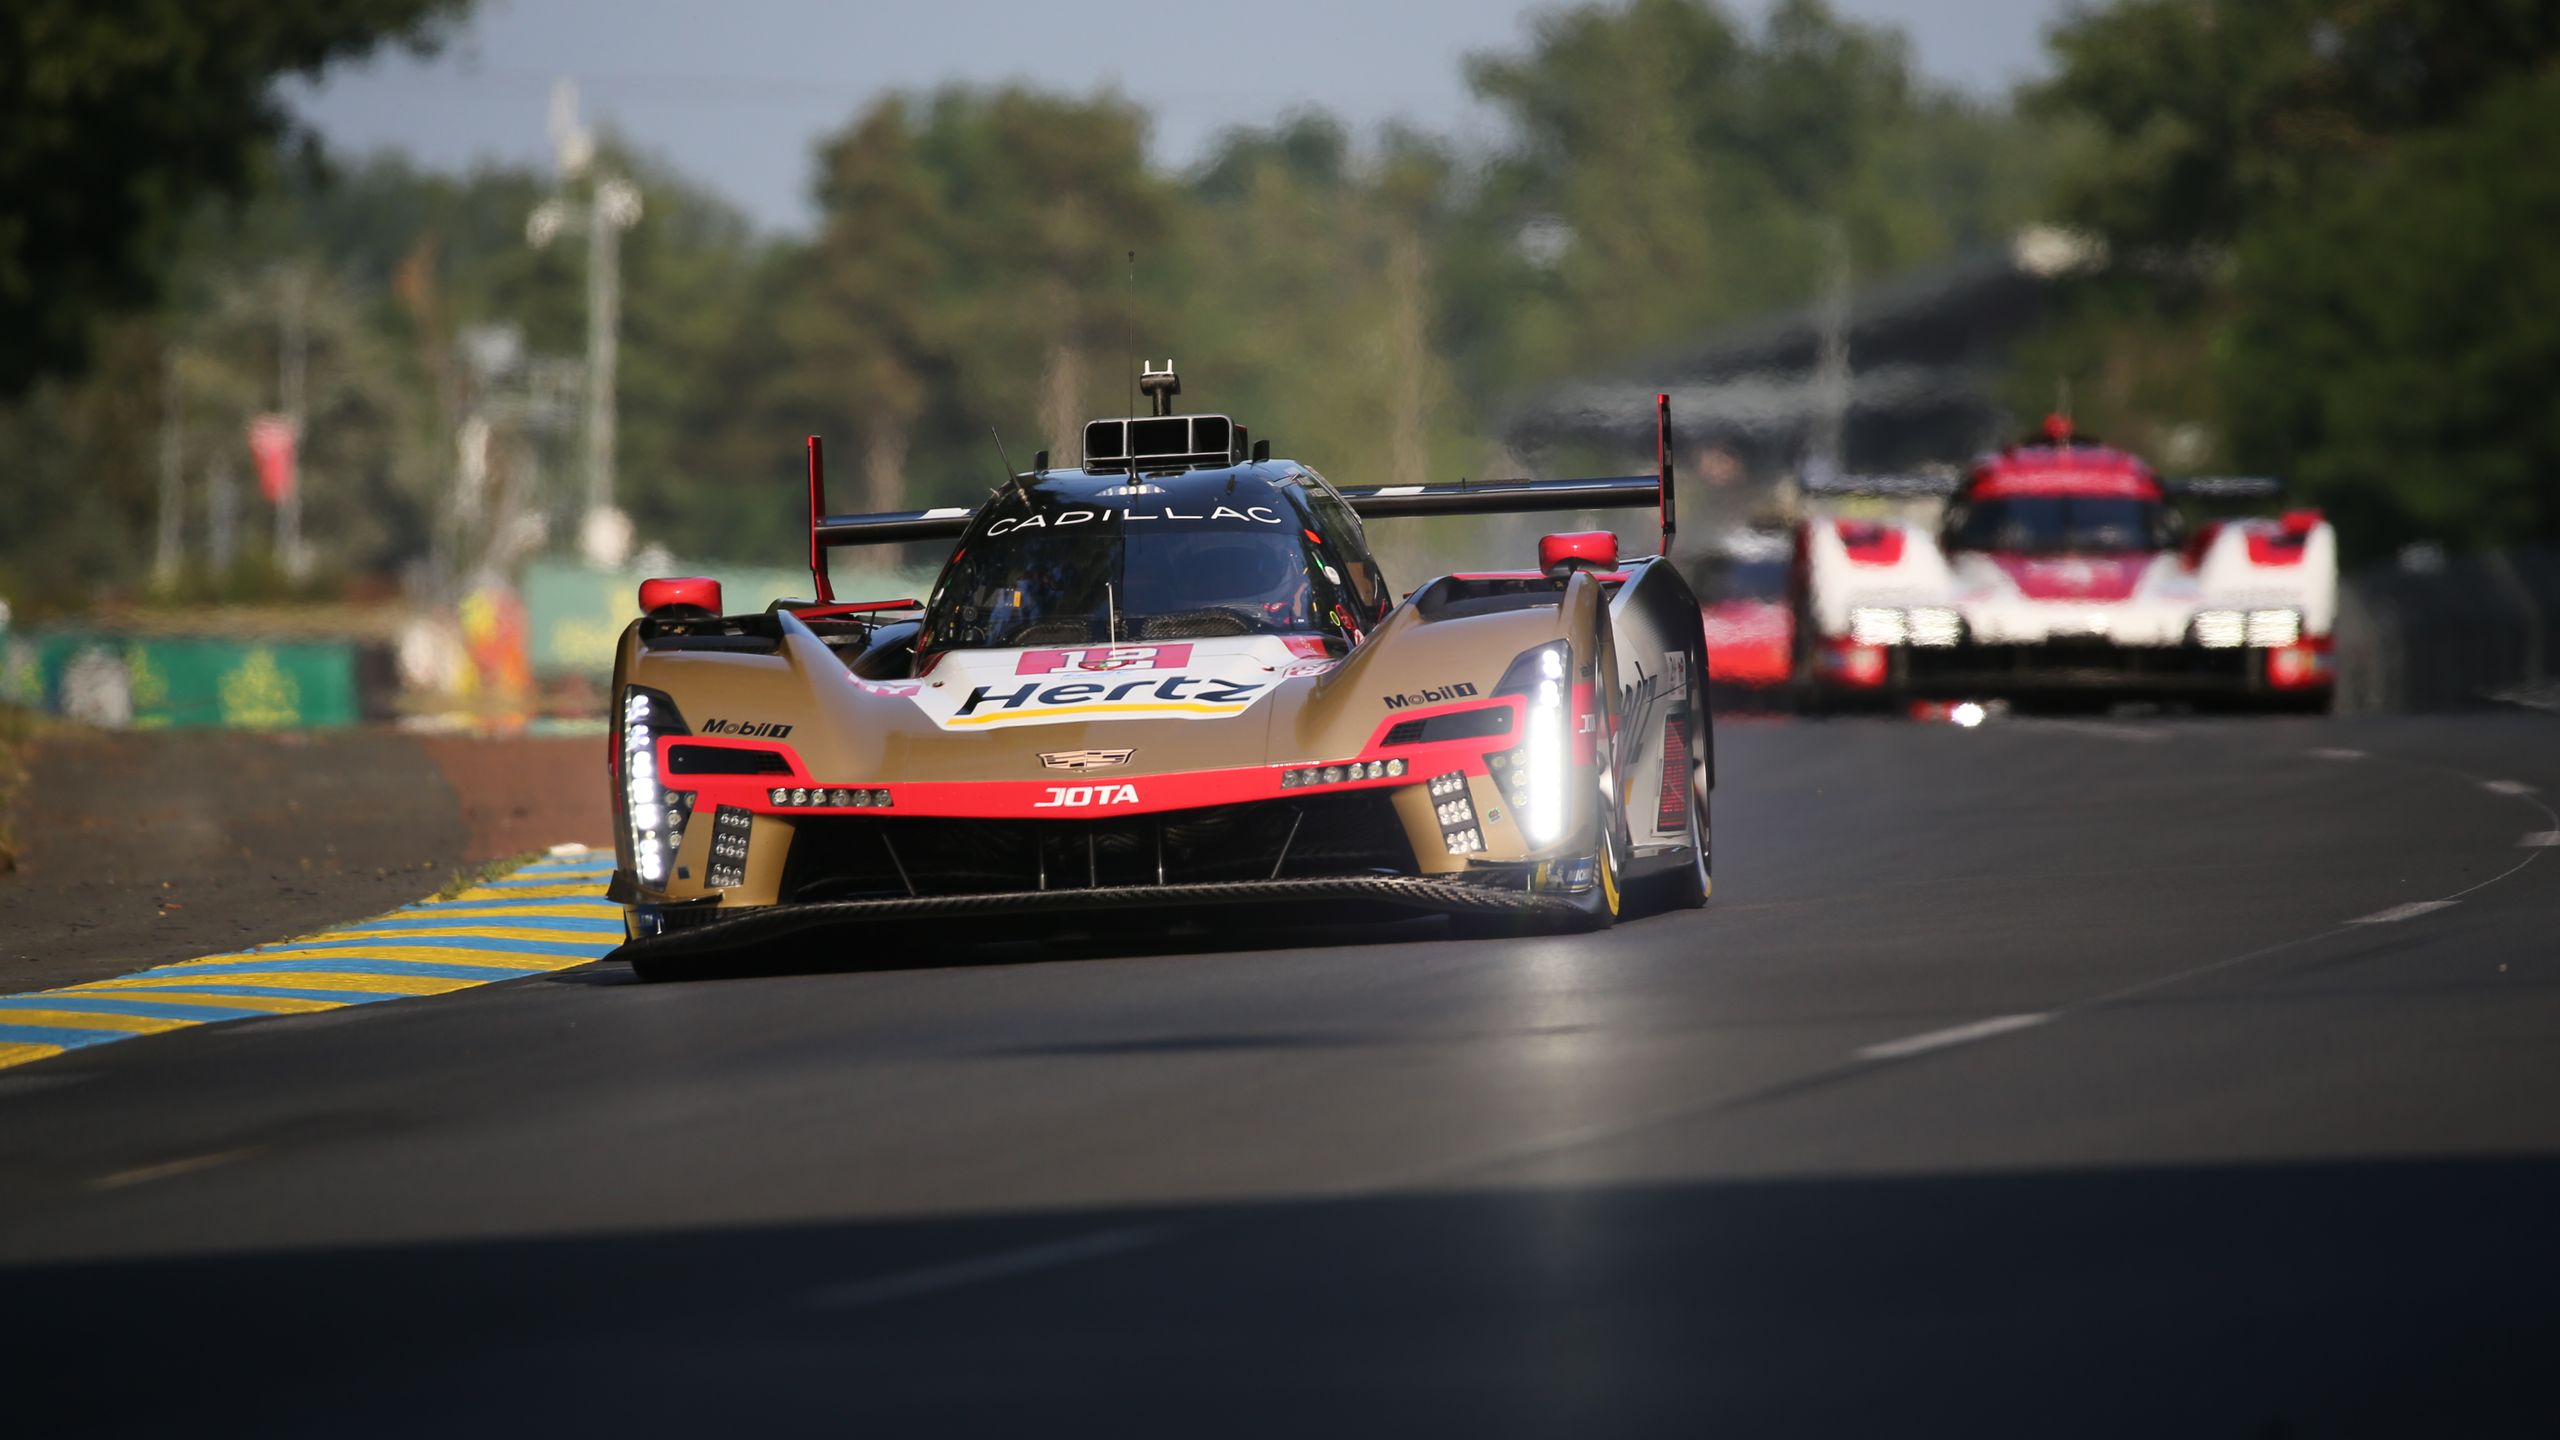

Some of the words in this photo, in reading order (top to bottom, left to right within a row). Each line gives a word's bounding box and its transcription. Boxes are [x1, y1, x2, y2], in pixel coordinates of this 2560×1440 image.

[987, 506, 1282, 537] CADILLAC
[1049, 647, 1159, 673] 12
[955, 676, 1266, 715] Hertz
[1033, 784, 1140, 807] JOTA
